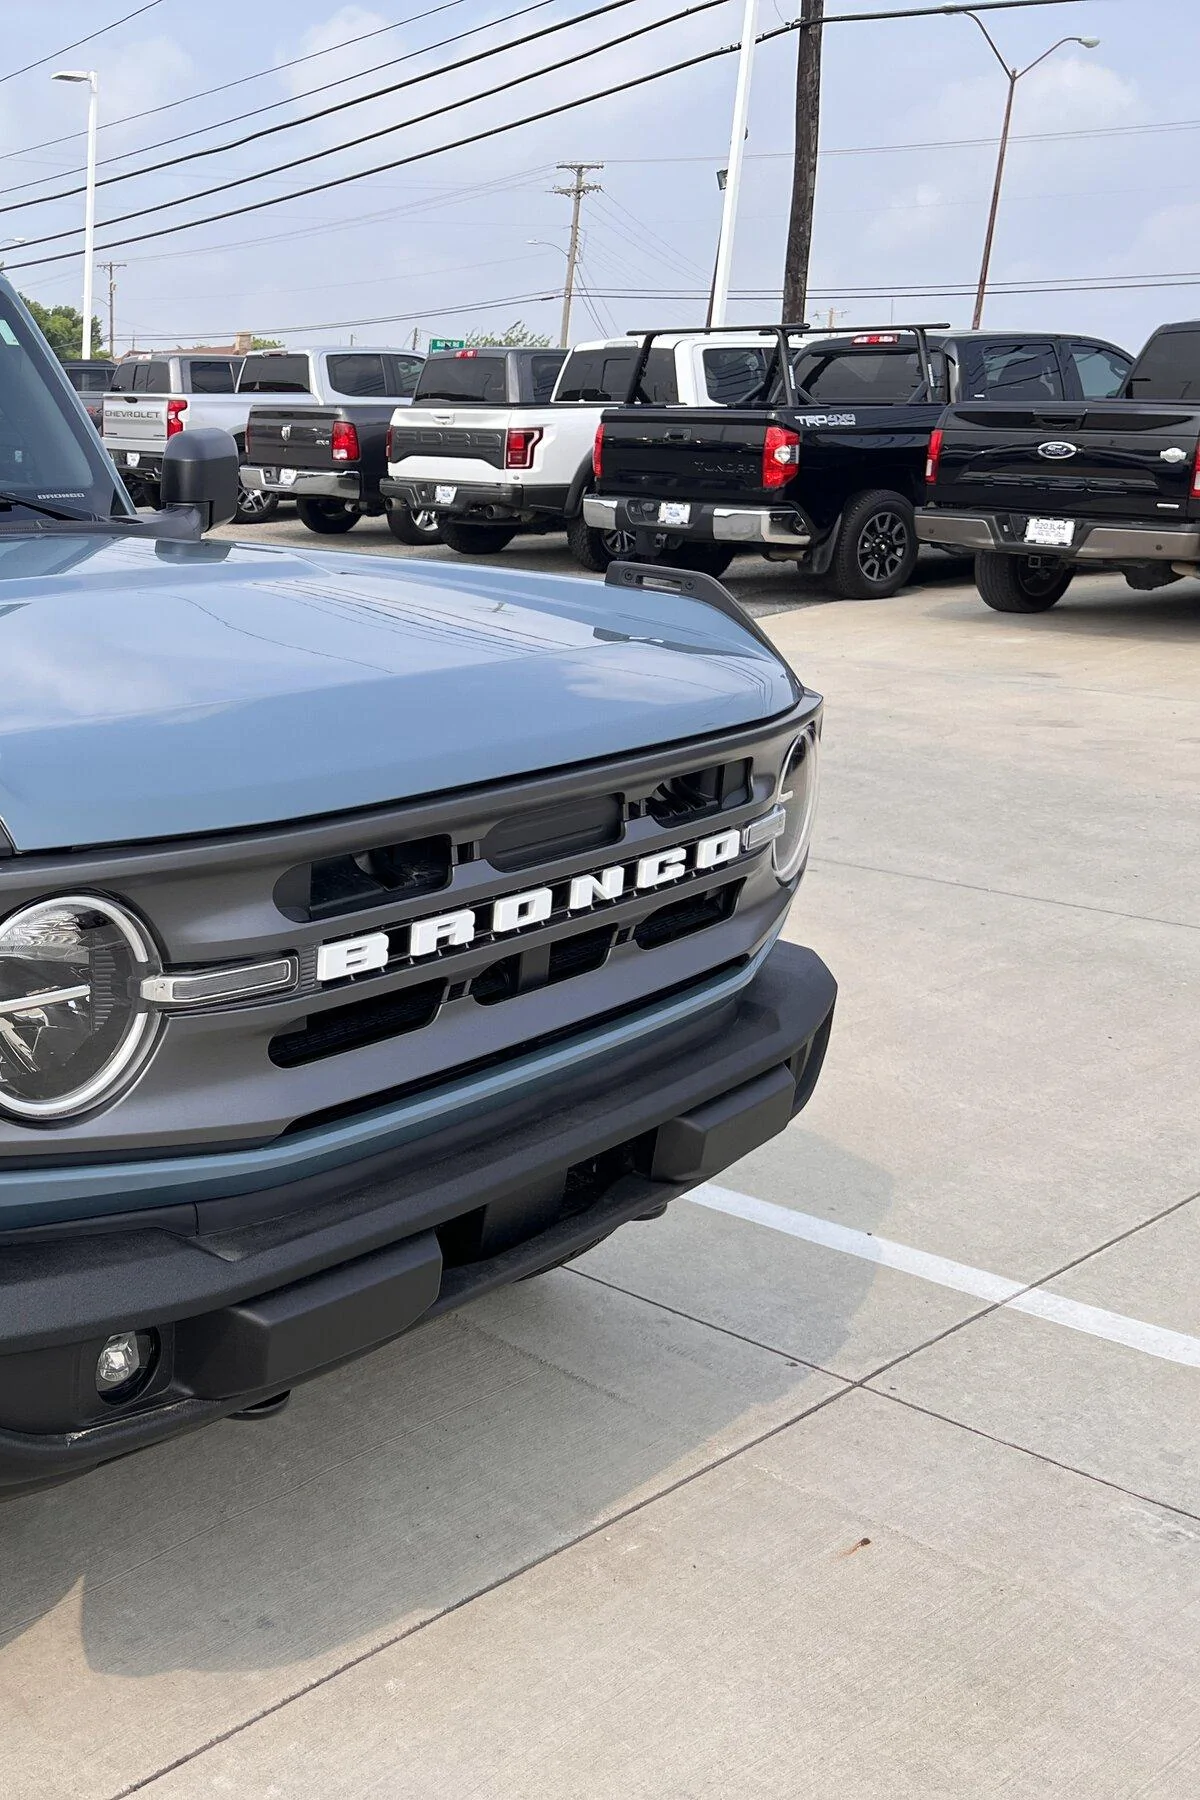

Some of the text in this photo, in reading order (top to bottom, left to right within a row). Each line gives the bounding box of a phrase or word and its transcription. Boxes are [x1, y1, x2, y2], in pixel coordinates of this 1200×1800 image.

[104, 410, 161, 419] CHEVROLET
[794, 414, 828, 427] TRD
[396, 429, 502, 447] FORD
[37, 492, 86, 500] BRONCO
[316, 829, 741, 982] BRONCO
